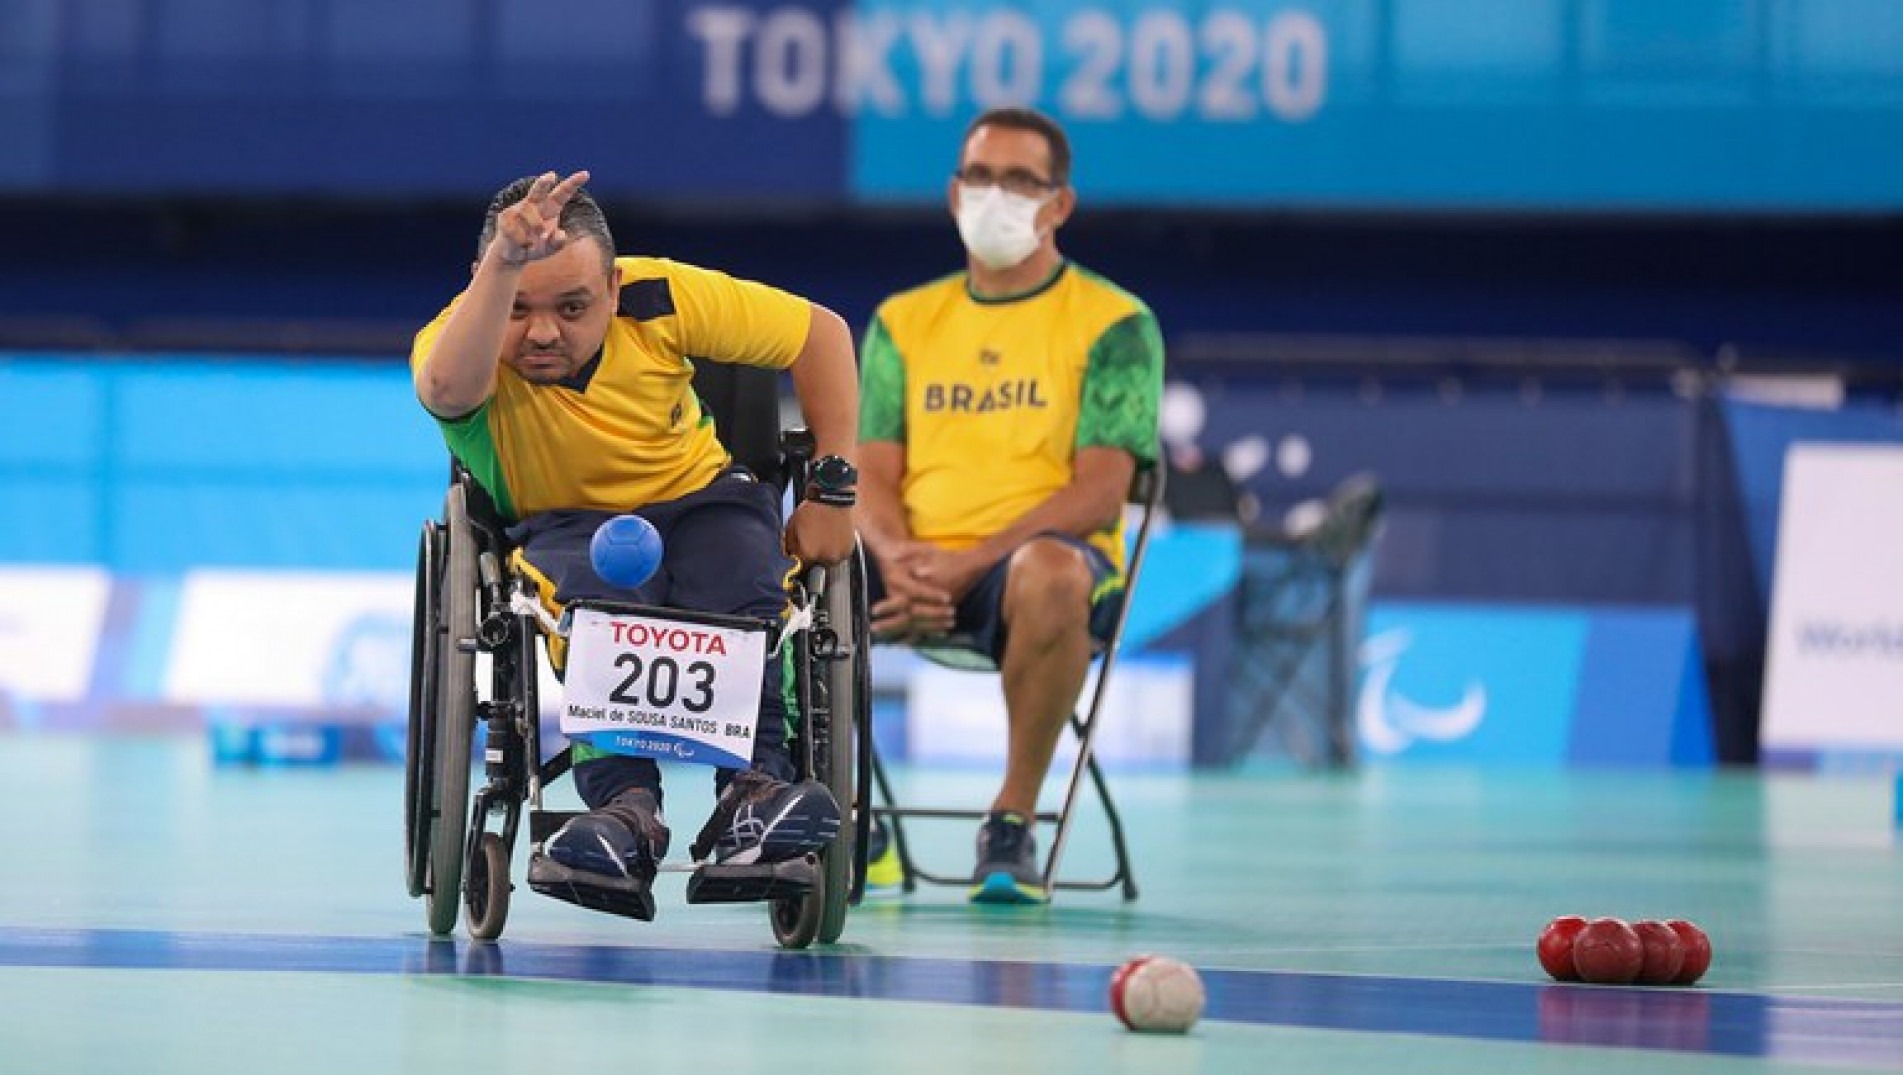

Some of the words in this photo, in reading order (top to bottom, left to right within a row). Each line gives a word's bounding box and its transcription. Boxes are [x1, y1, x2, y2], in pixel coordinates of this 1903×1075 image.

[689, 7, 1043, 118] TOKYO
[1060, 10, 1327, 121] 2020
[925, 378, 1047, 413] BRASIL
[610, 621, 727, 655] TOYOTA
[609, 652, 716, 713] 203
[567, 705, 605, 720] Maciel
[609, 709, 624, 721] de
[627, 710, 667, 727] SOUSA
[670, 715, 718, 734] SANTOS
[725, 722, 751, 739] BRA
